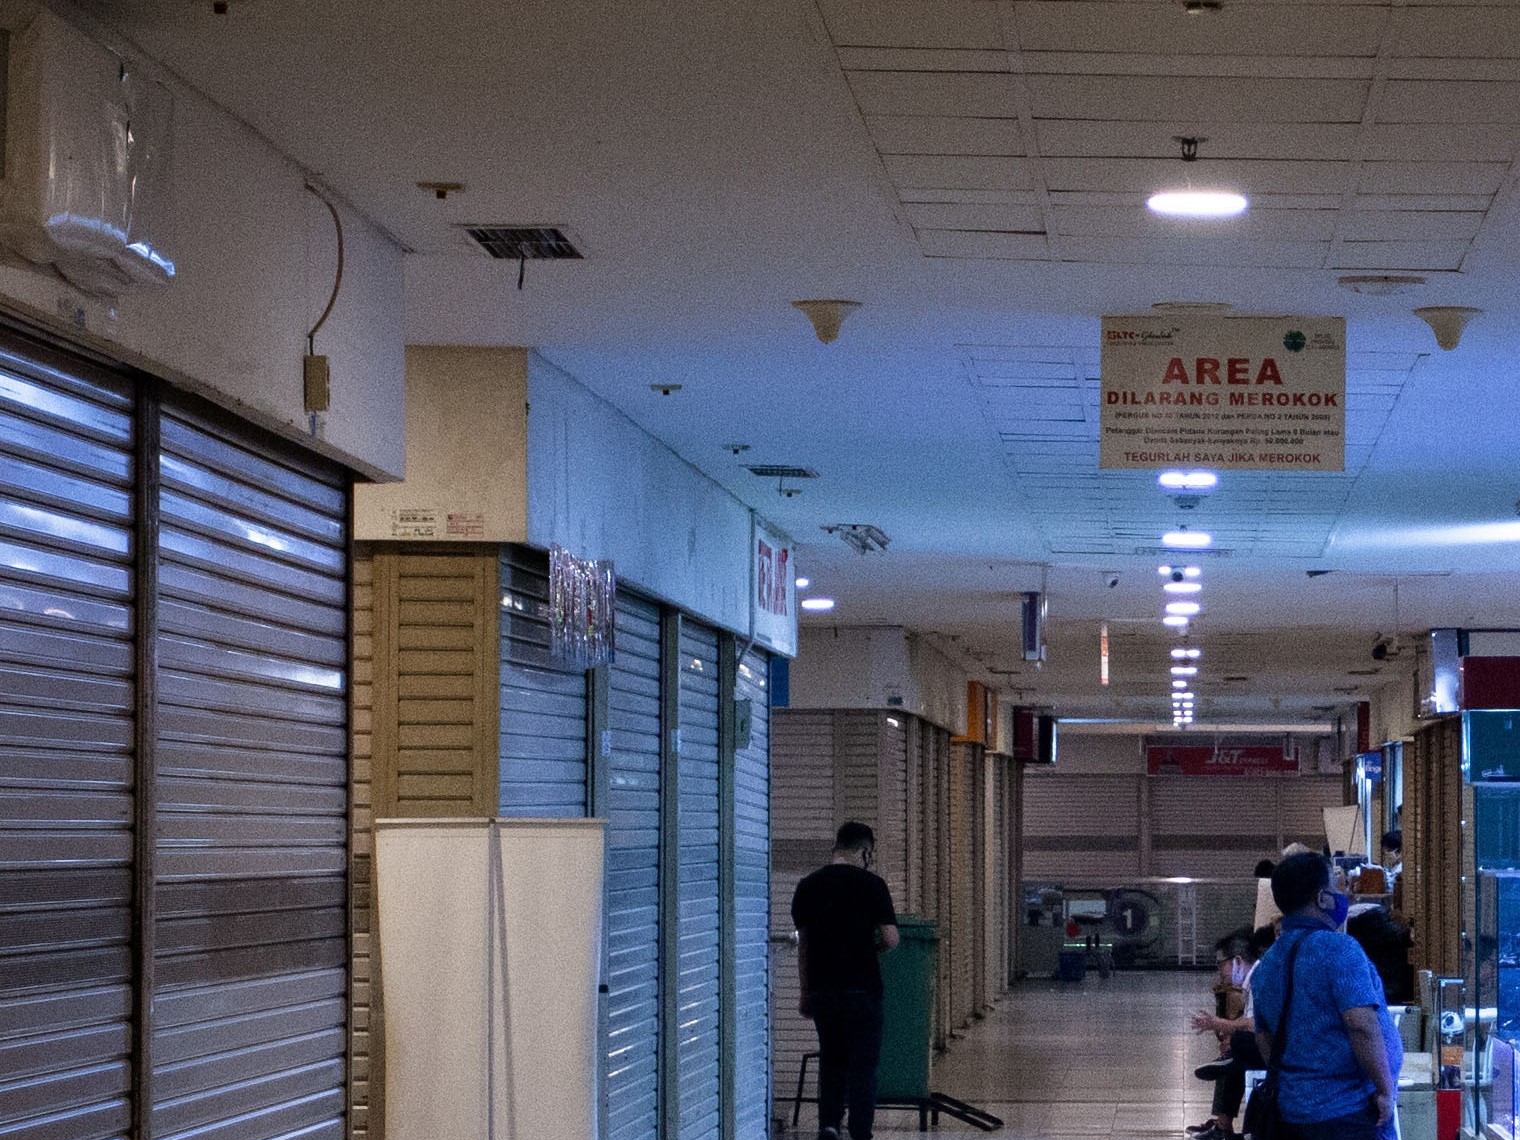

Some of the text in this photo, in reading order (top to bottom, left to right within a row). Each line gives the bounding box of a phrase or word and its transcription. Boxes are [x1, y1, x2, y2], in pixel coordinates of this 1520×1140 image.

[1162, 357, 1284, 385] AREA
[1107, 391, 1338, 407] DILARANG MEROKOK
[1283, 413, 1309, 421] TAHUN
[1124, 452, 1321, 464] TEGURLAH SAYA JIKA MEROKOK
[1205, 749, 1245, 764] J&T
[1122, 908, 1133, 930] 1
